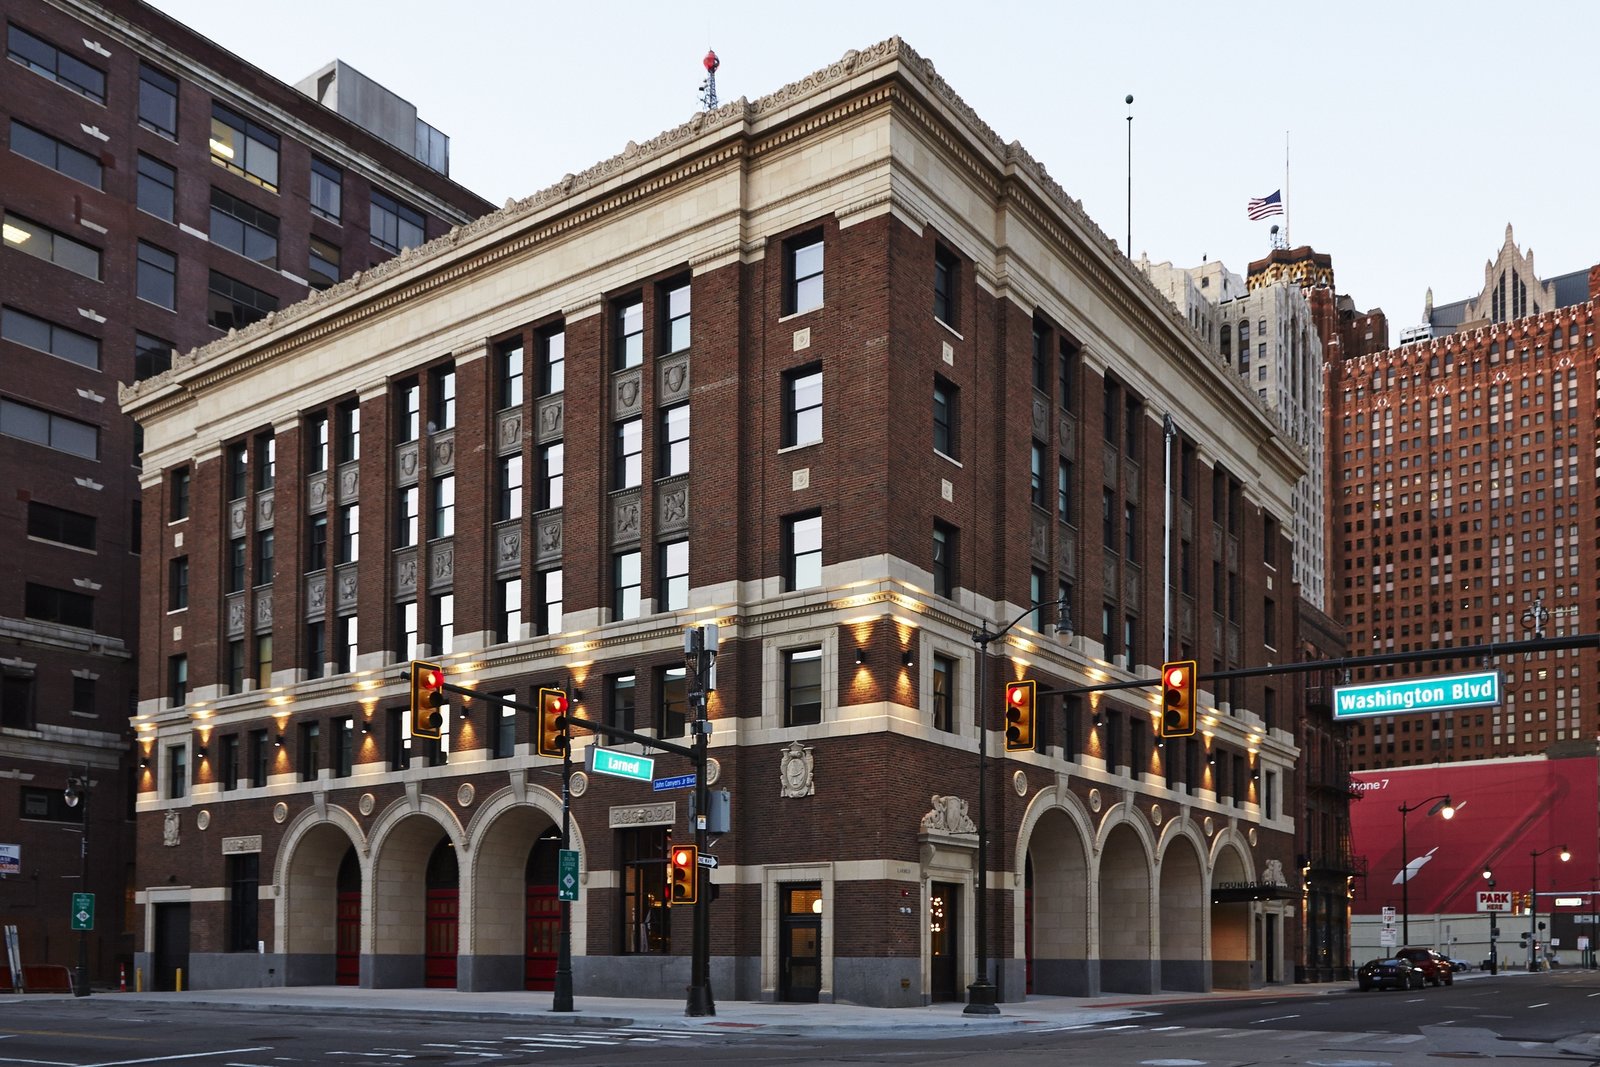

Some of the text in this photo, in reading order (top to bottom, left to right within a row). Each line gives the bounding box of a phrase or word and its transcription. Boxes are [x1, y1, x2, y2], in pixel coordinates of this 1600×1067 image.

[1340, 680, 1492, 711] Washington Blvd
[608, 757, 640, 773] Larned
[655, 781, 665, 789] John
[665, 779, 681, 787] Conyers
[1381, 779, 1390, 790] 7
[1218, 880, 1277, 889] FOUNDATION
[1480, 893, 1509, 903] PARK
